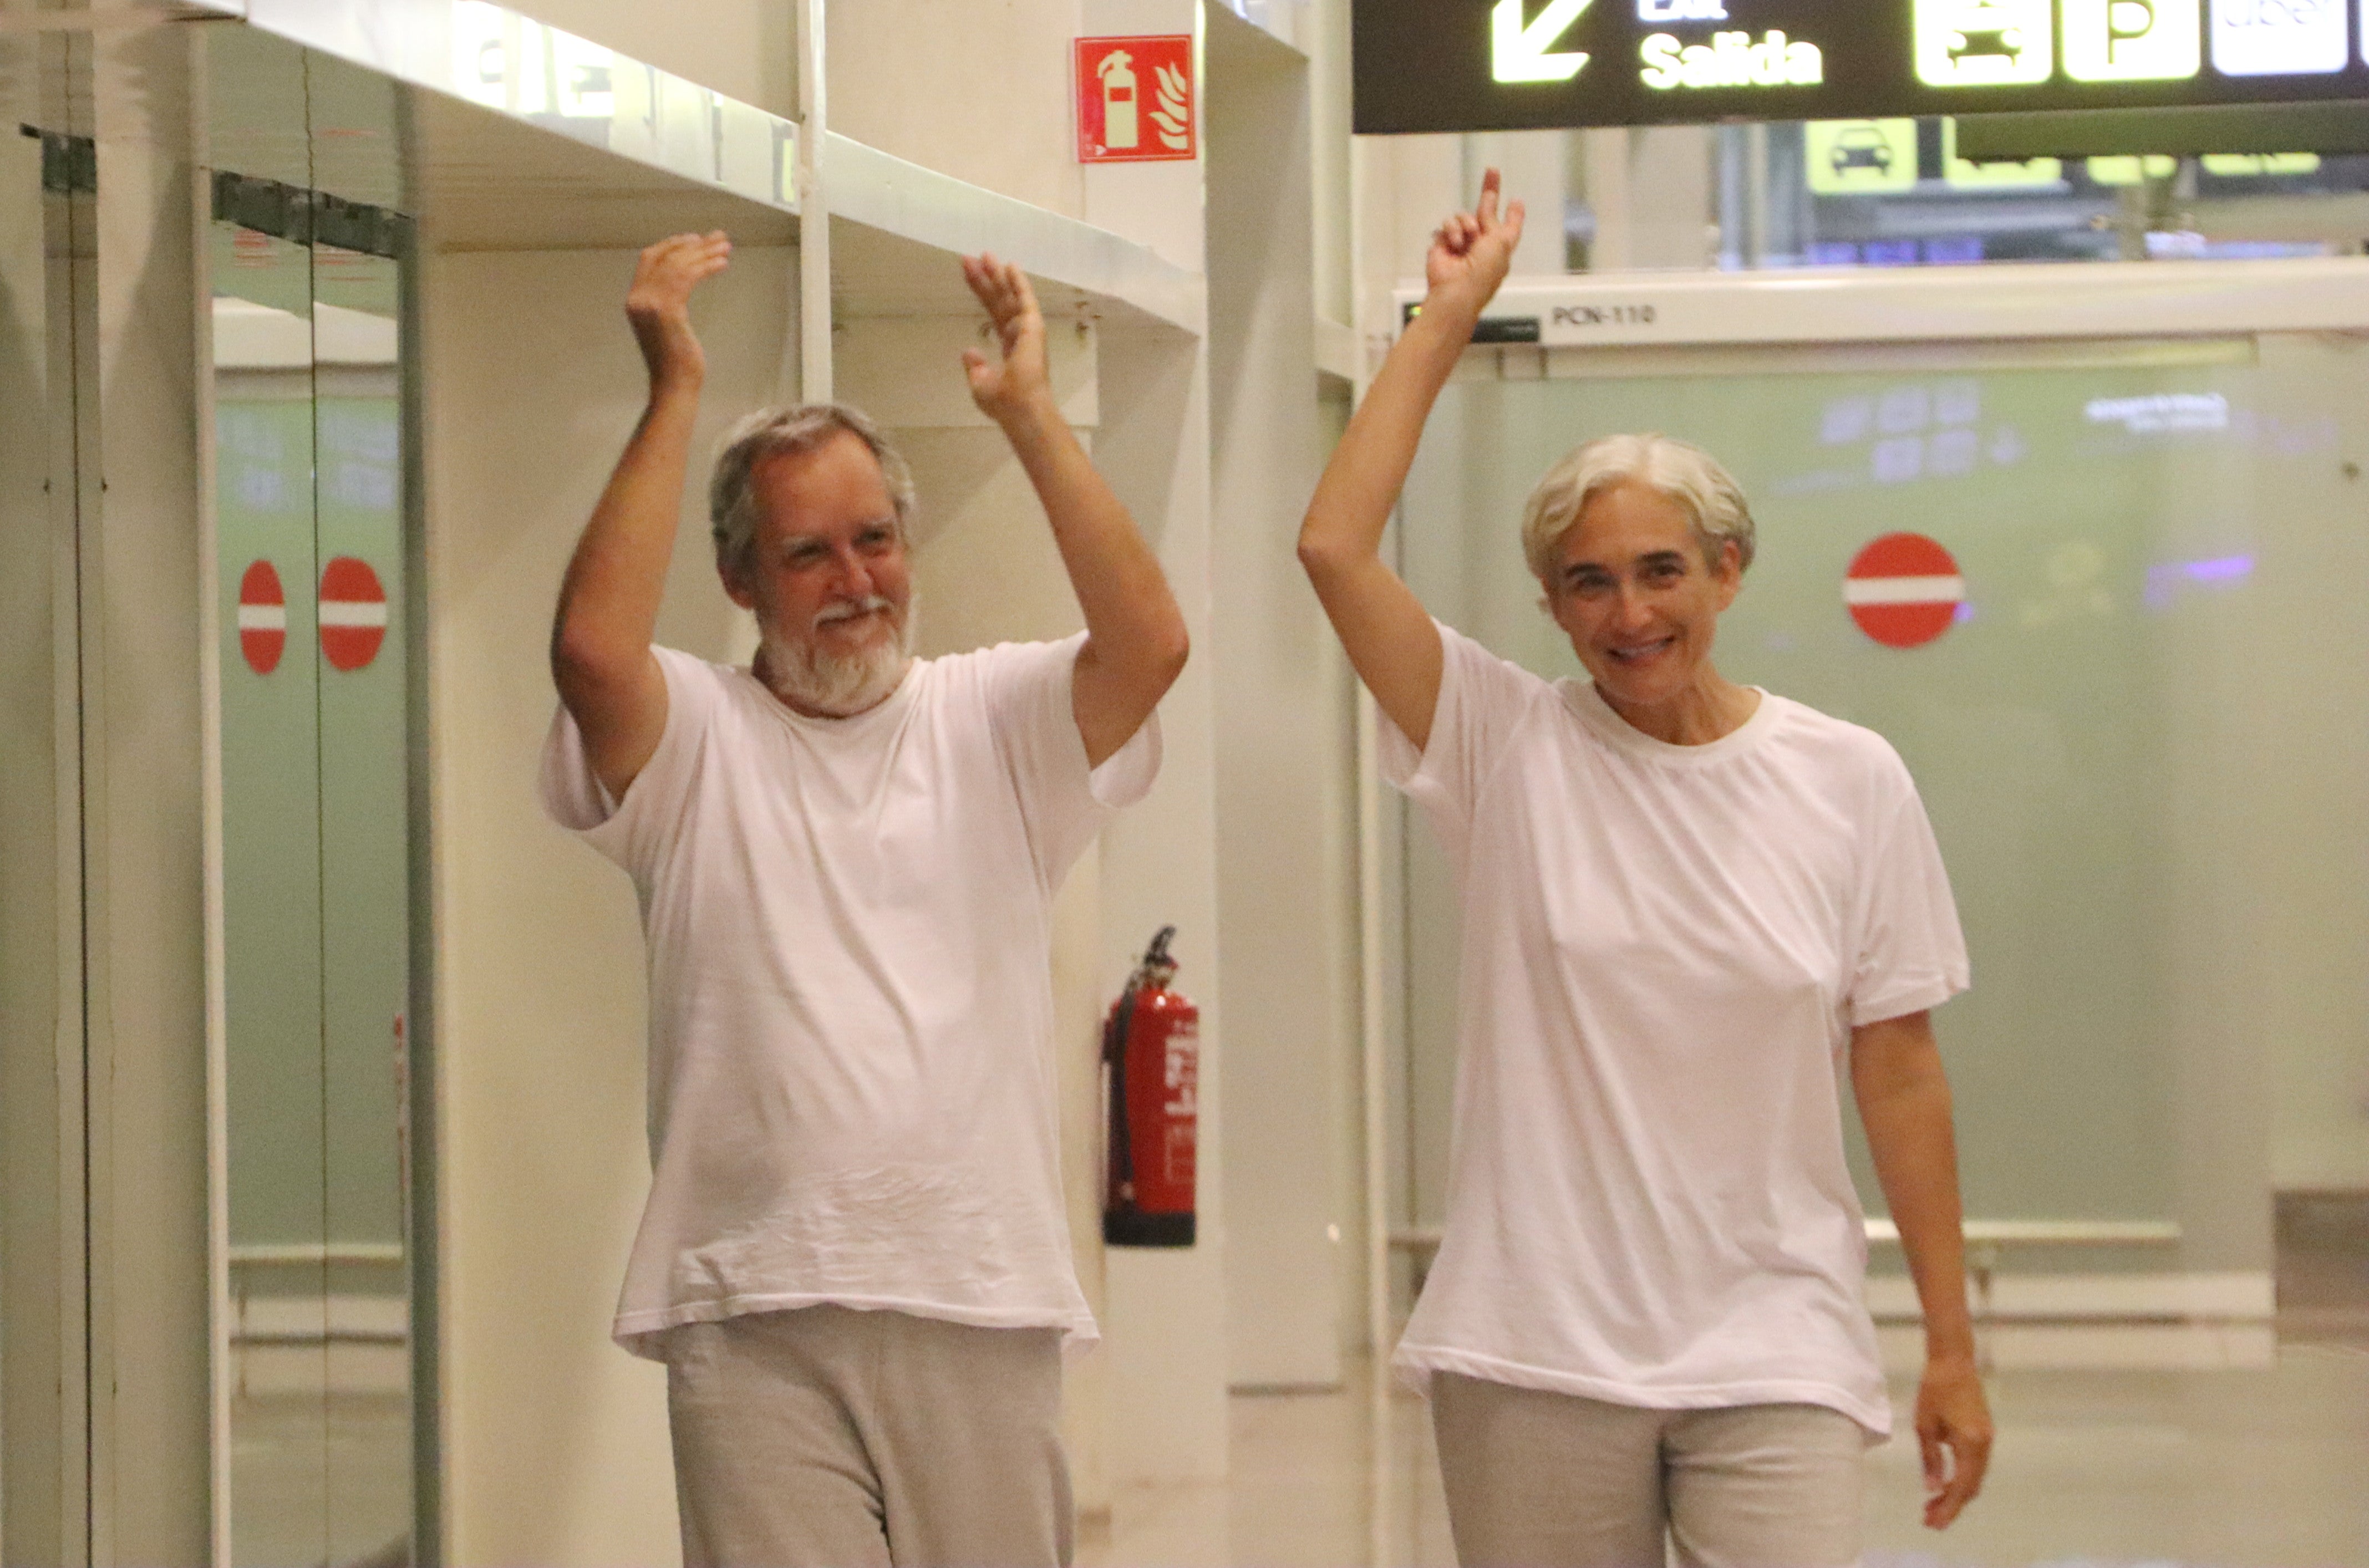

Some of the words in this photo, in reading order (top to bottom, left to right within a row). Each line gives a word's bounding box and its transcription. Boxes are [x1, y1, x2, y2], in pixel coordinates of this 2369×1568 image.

[1640, 29, 1823, 90] Salida
[2107, 0, 2156, 64] P
[1552, 304, 1657, 325] PCN-110
